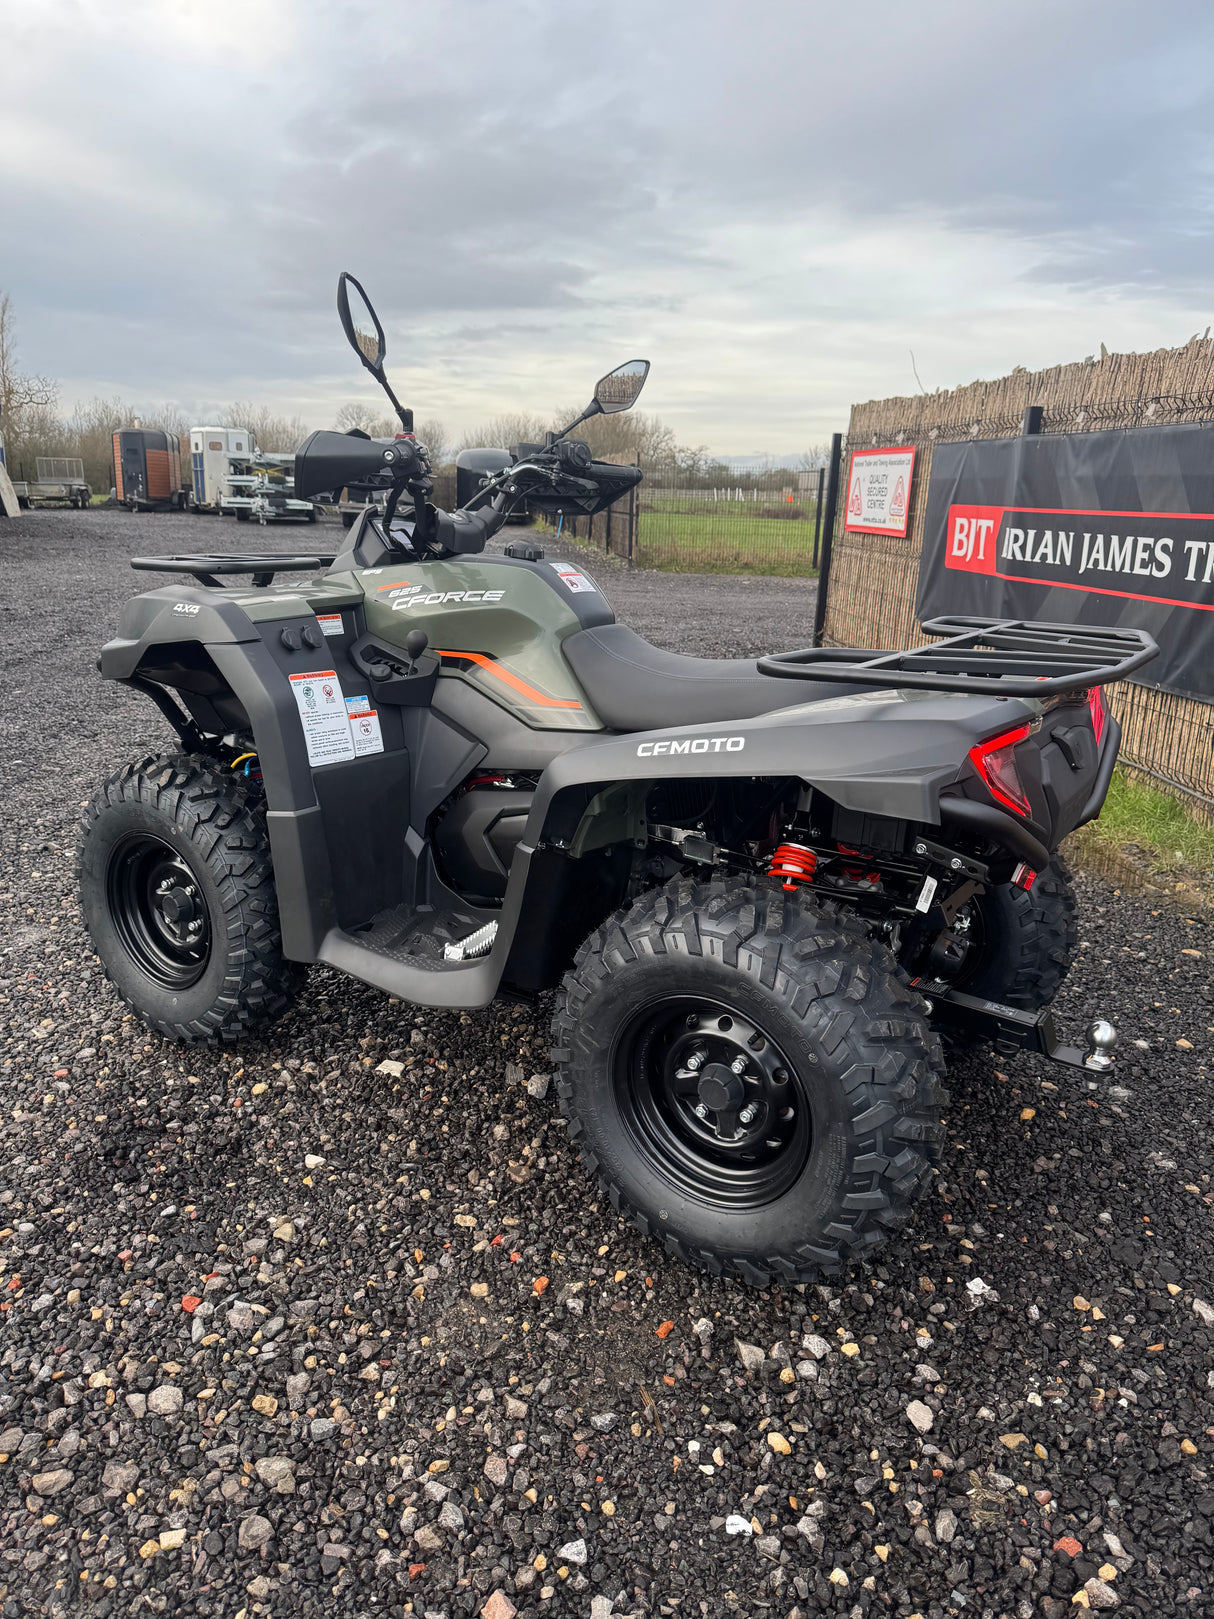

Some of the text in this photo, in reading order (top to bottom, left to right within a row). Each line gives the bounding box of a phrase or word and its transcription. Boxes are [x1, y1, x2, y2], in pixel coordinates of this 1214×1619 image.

[869, 474, 889, 484] QUALITY
[867, 487, 888, 497] SECURED
[867, 499, 885, 510] CENTRE
[951, 517, 994, 562] BJT
[1078, 532, 1174, 578] JAMES
[388, 585, 422, 598] 625
[392, 590, 506, 611] CFORCE
[637, 737, 745, 757] CFMOTO
